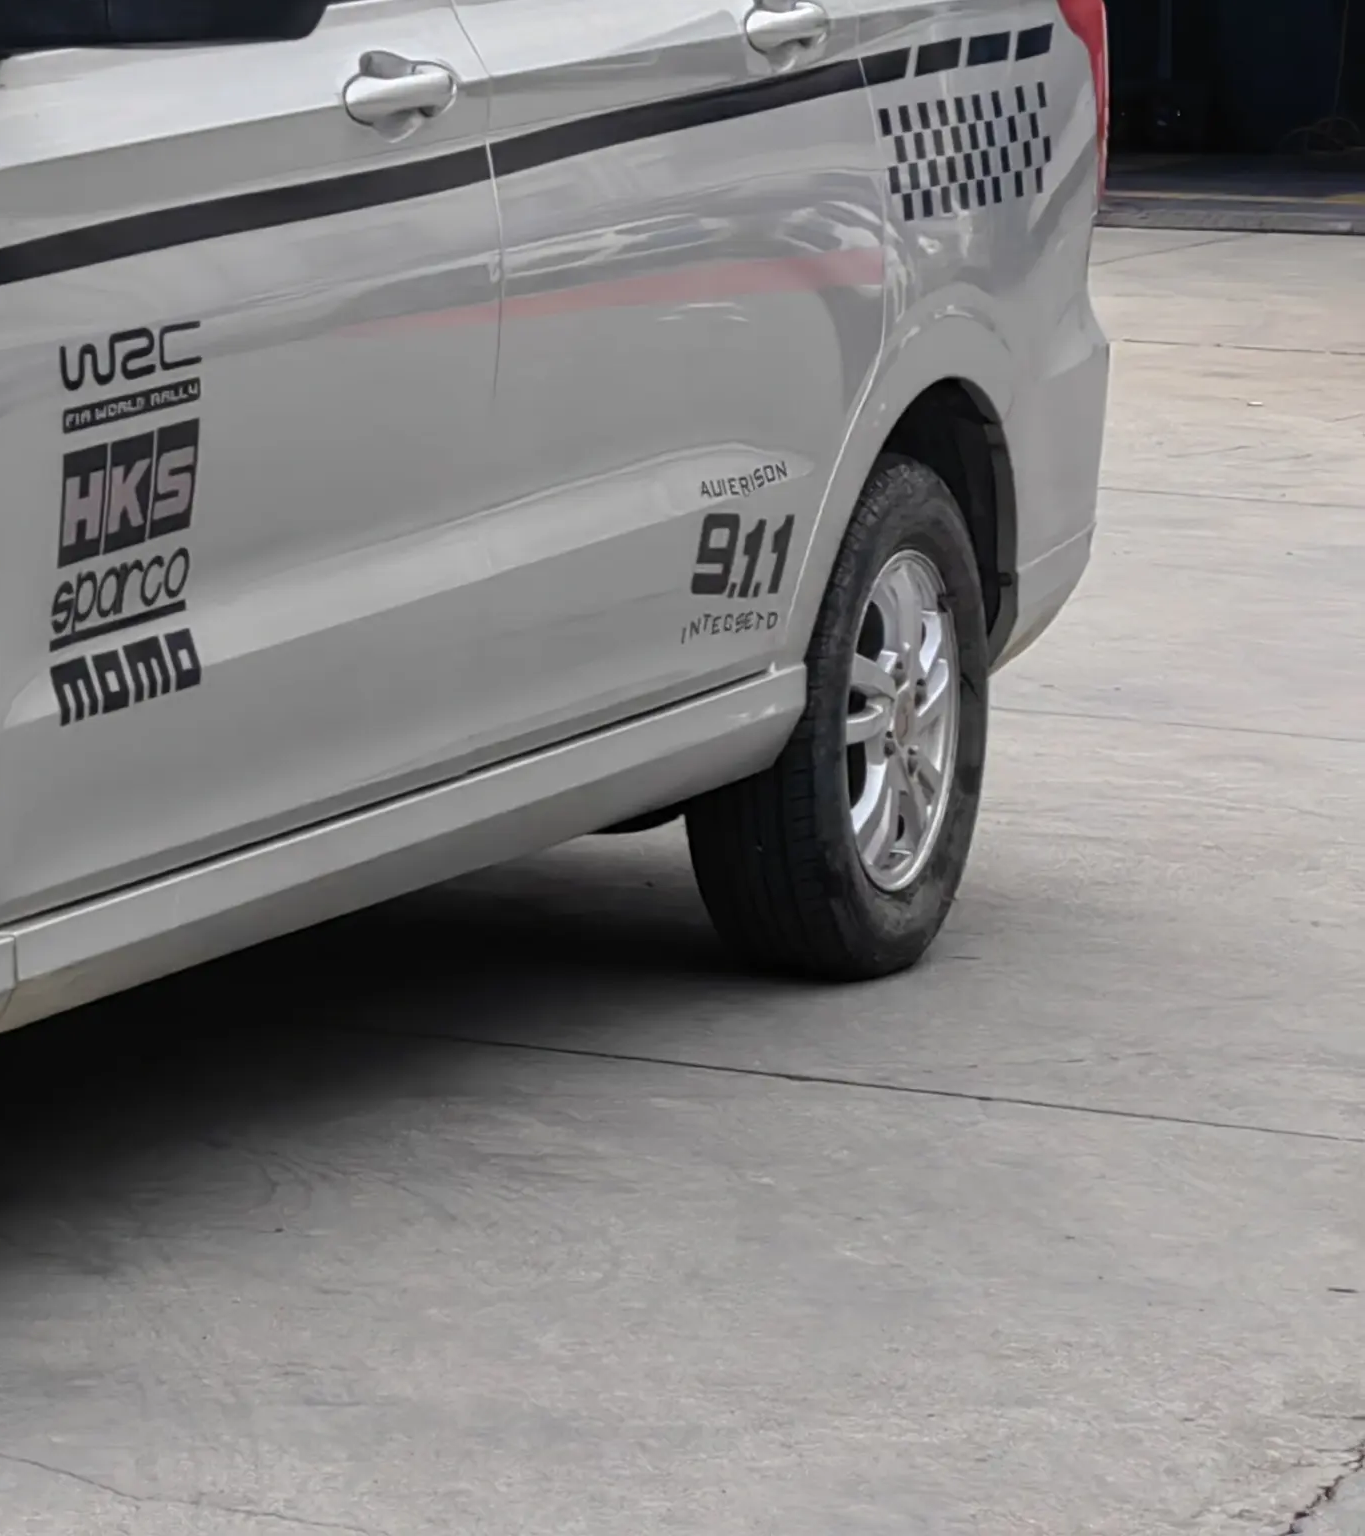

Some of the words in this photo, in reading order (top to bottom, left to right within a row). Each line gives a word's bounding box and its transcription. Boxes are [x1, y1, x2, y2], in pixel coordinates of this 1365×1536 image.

[59, 320, 203, 392] WRC
[61, 446, 197, 548] HKS
[50, 547, 191, 636] sparco
